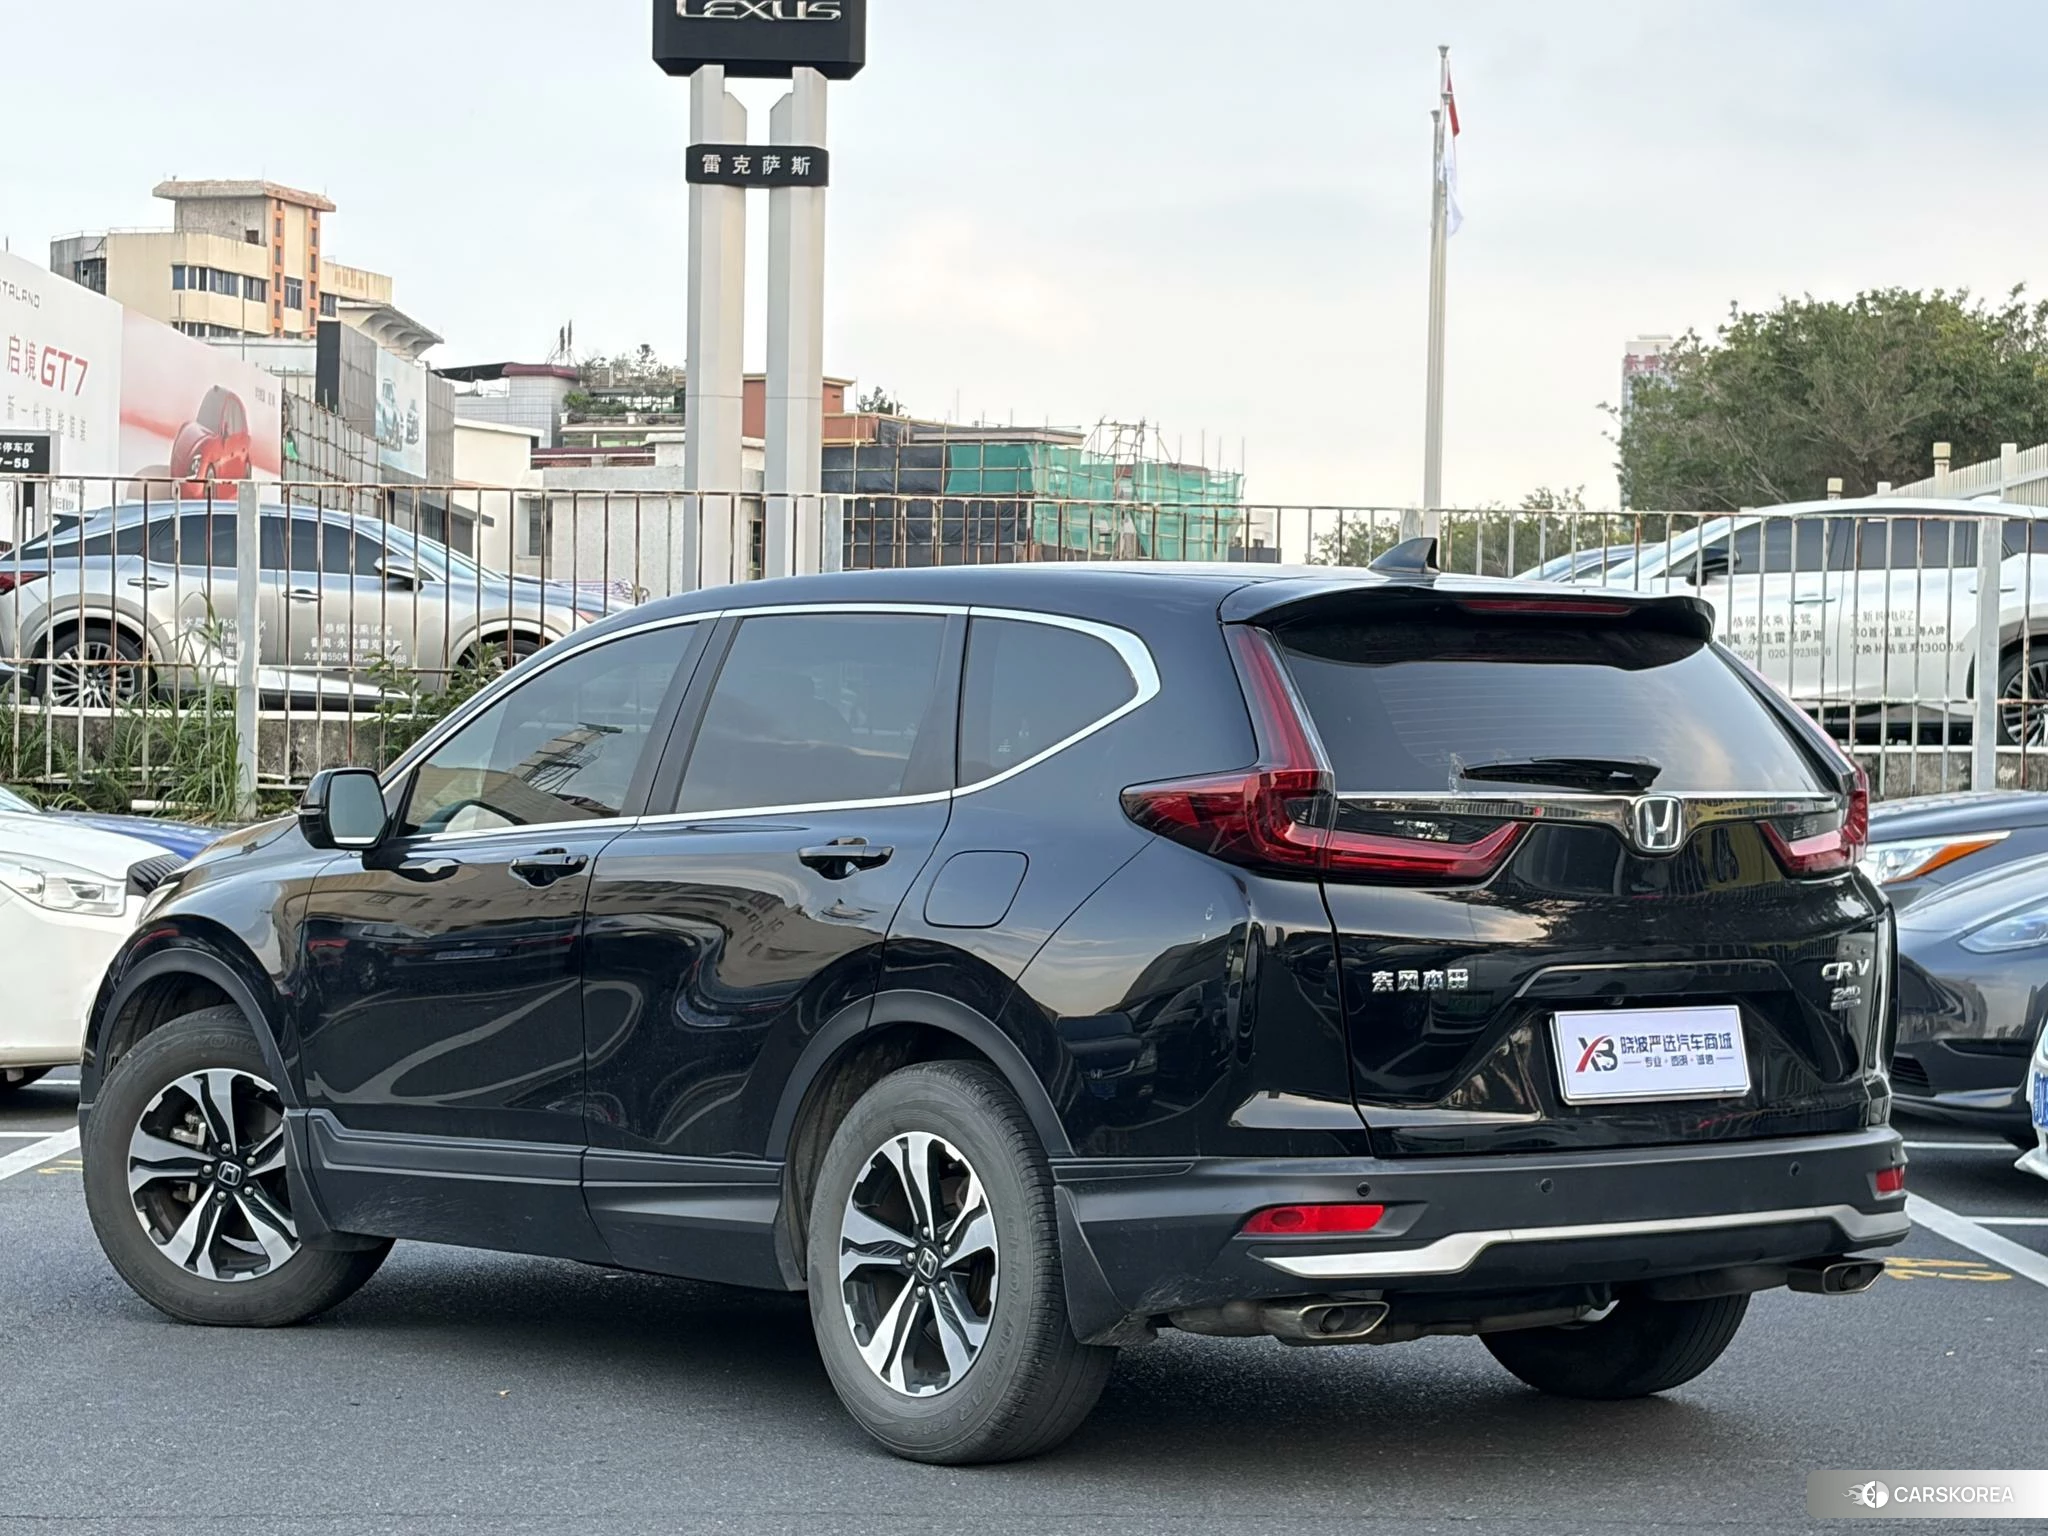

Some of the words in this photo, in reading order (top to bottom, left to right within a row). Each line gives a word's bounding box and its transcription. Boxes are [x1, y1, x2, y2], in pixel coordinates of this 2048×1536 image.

[676, 0, 842, 21] LEXUS
[702, 154, 811, 176] 雷克萨斯
[0, 281, 40, 309] TALAND
[0, 441, 34, 454] 停车区
[1371, 968, 1469, 993] 东风本田
[1620, 1032, 1733, 1054] 晓波严选汽车商城
